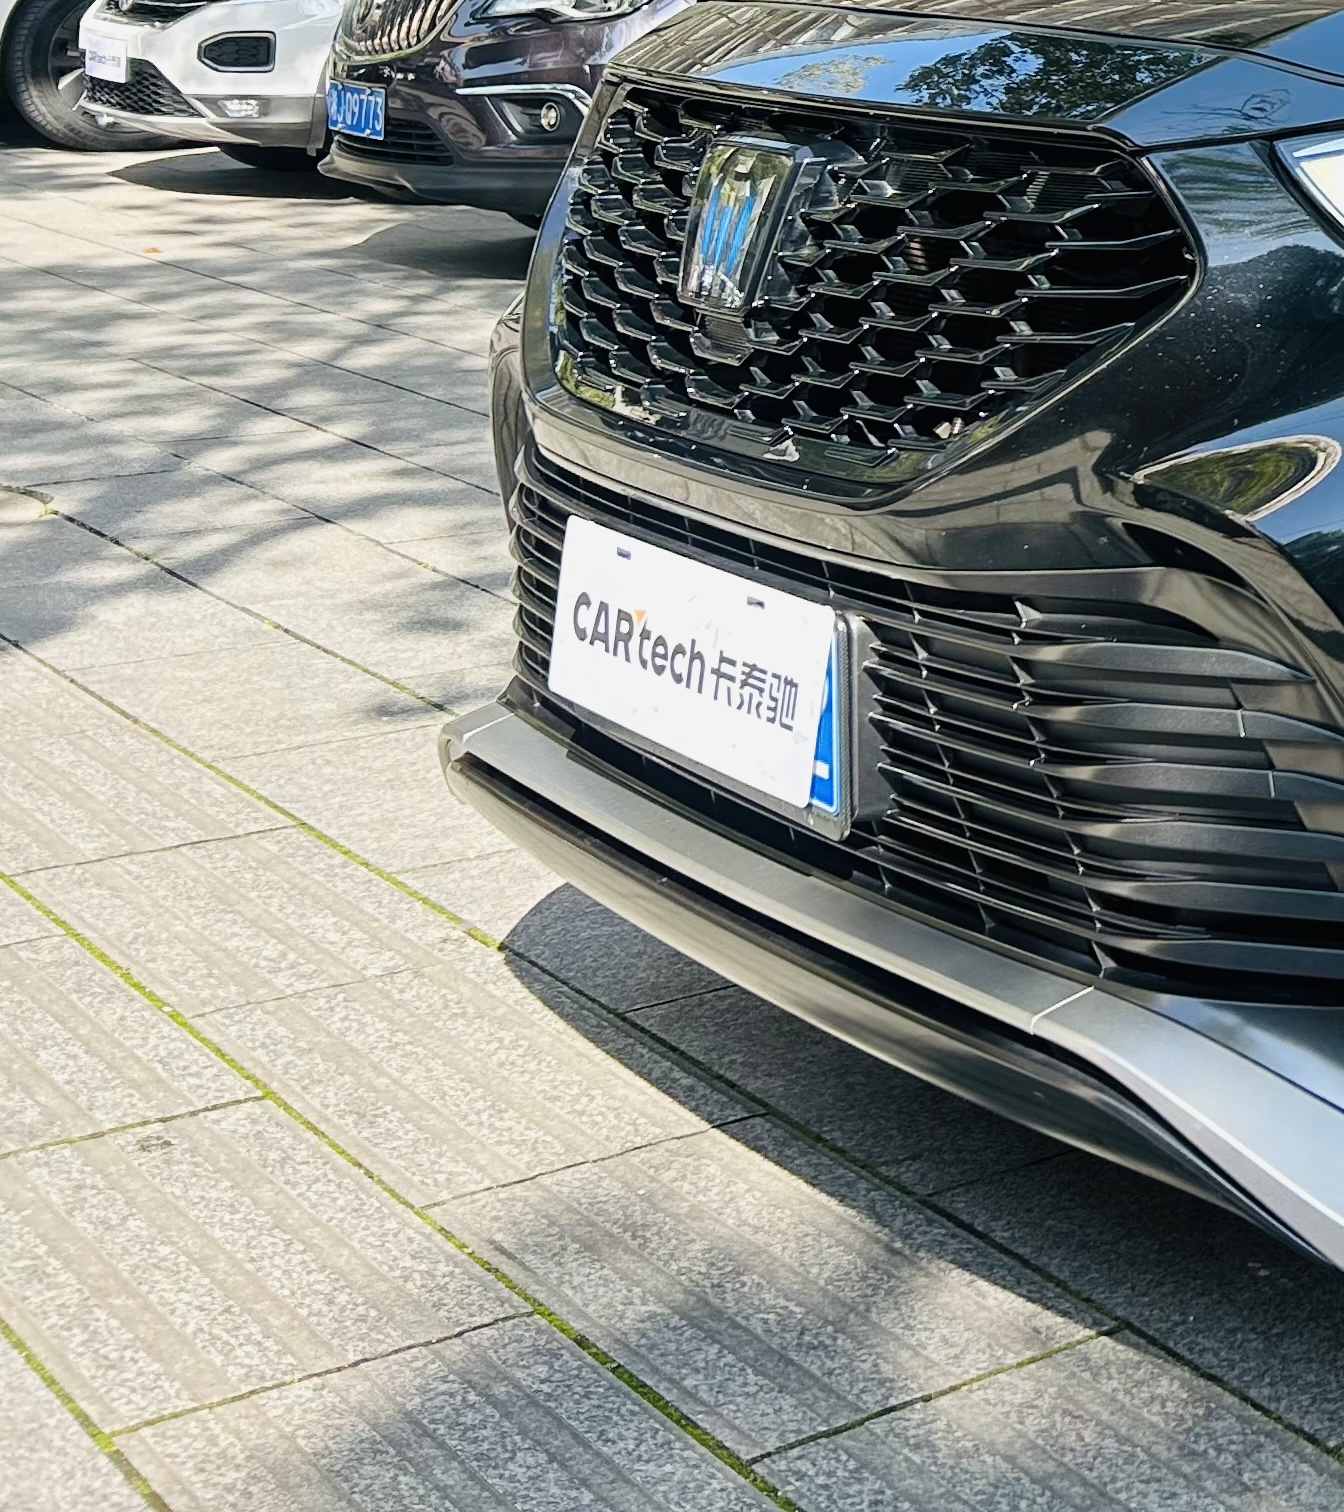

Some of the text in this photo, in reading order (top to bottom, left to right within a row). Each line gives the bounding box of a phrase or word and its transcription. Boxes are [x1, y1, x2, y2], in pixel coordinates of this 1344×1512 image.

[573, 592, 799, 731] CARtech 卡泰驰
